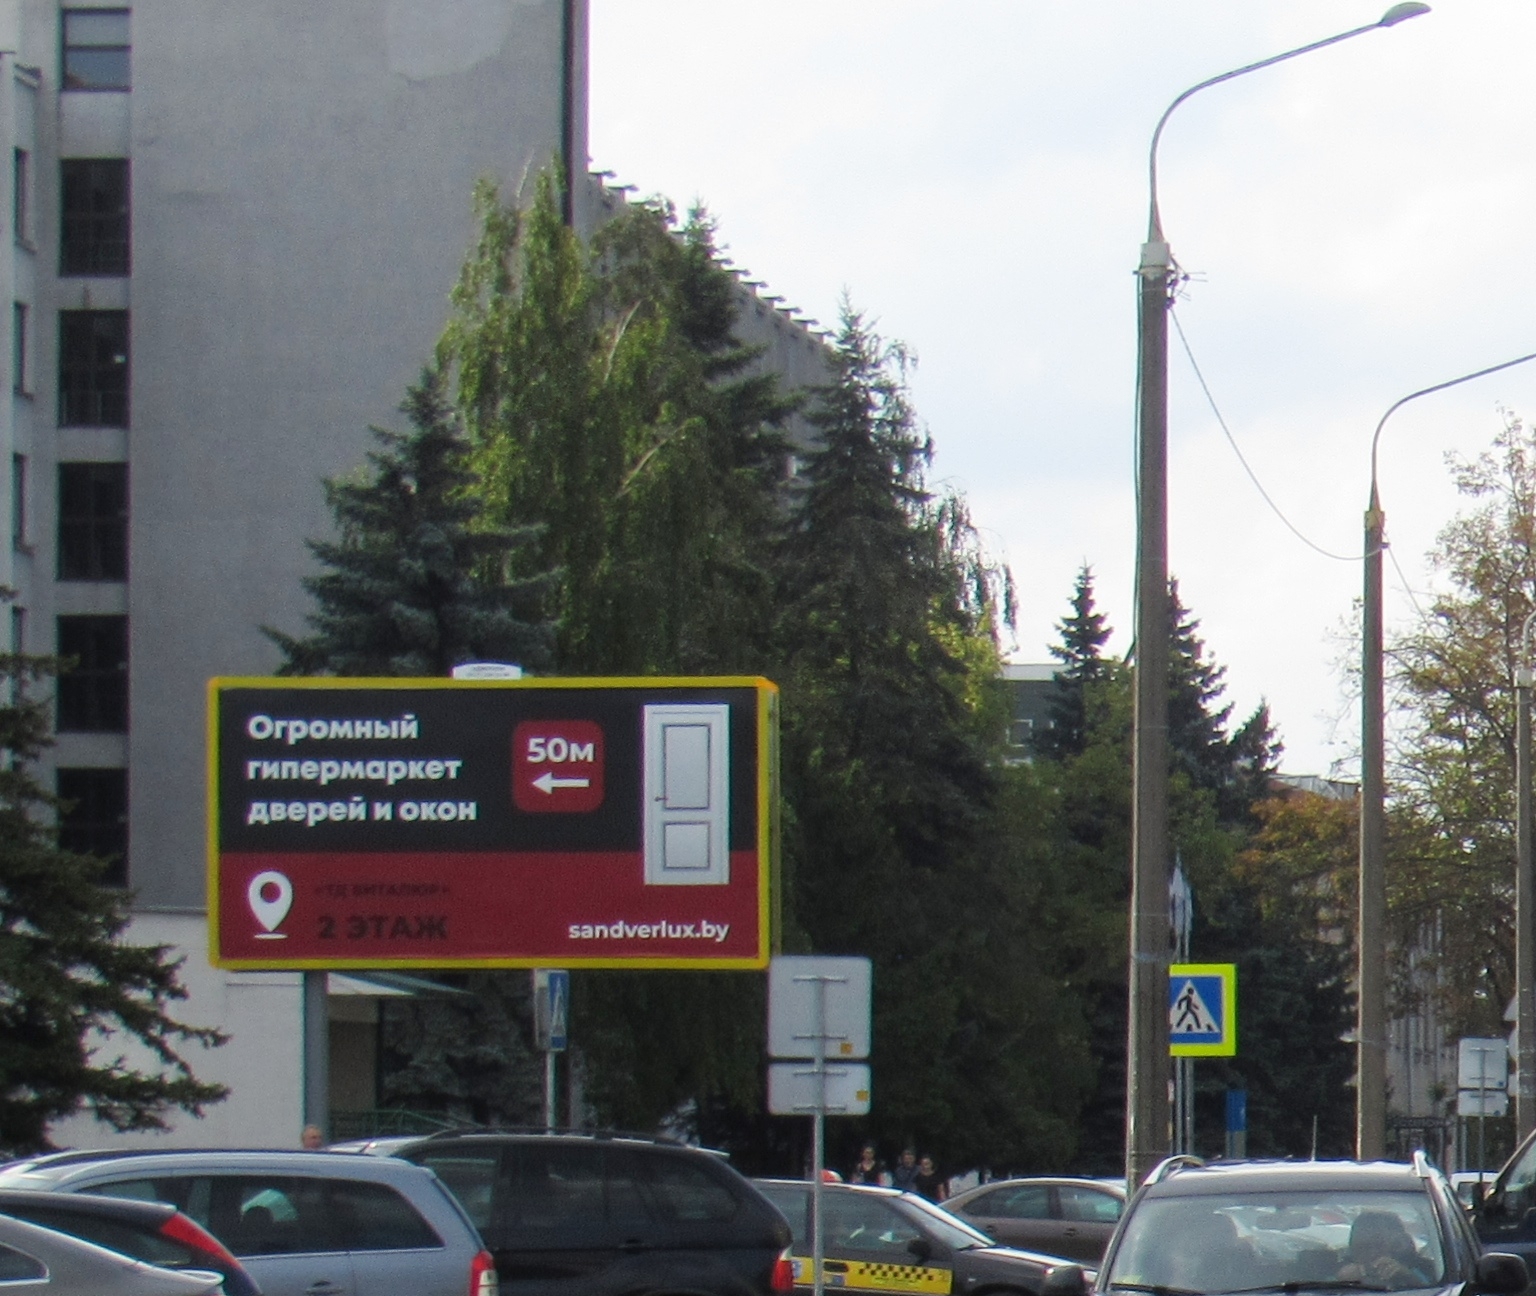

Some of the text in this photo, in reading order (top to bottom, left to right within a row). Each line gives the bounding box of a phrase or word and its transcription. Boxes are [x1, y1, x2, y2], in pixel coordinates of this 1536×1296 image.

[247, 713, 419, 745] Огромный
[526, 737, 595, 762] 50м
[247, 759, 463, 785] гипермаркет
[247, 796, 477, 827] дверей и окон
[318, 915, 448, 939] 2 ЭТАЖ
[568, 919, 729, 943] sandverlux.by
